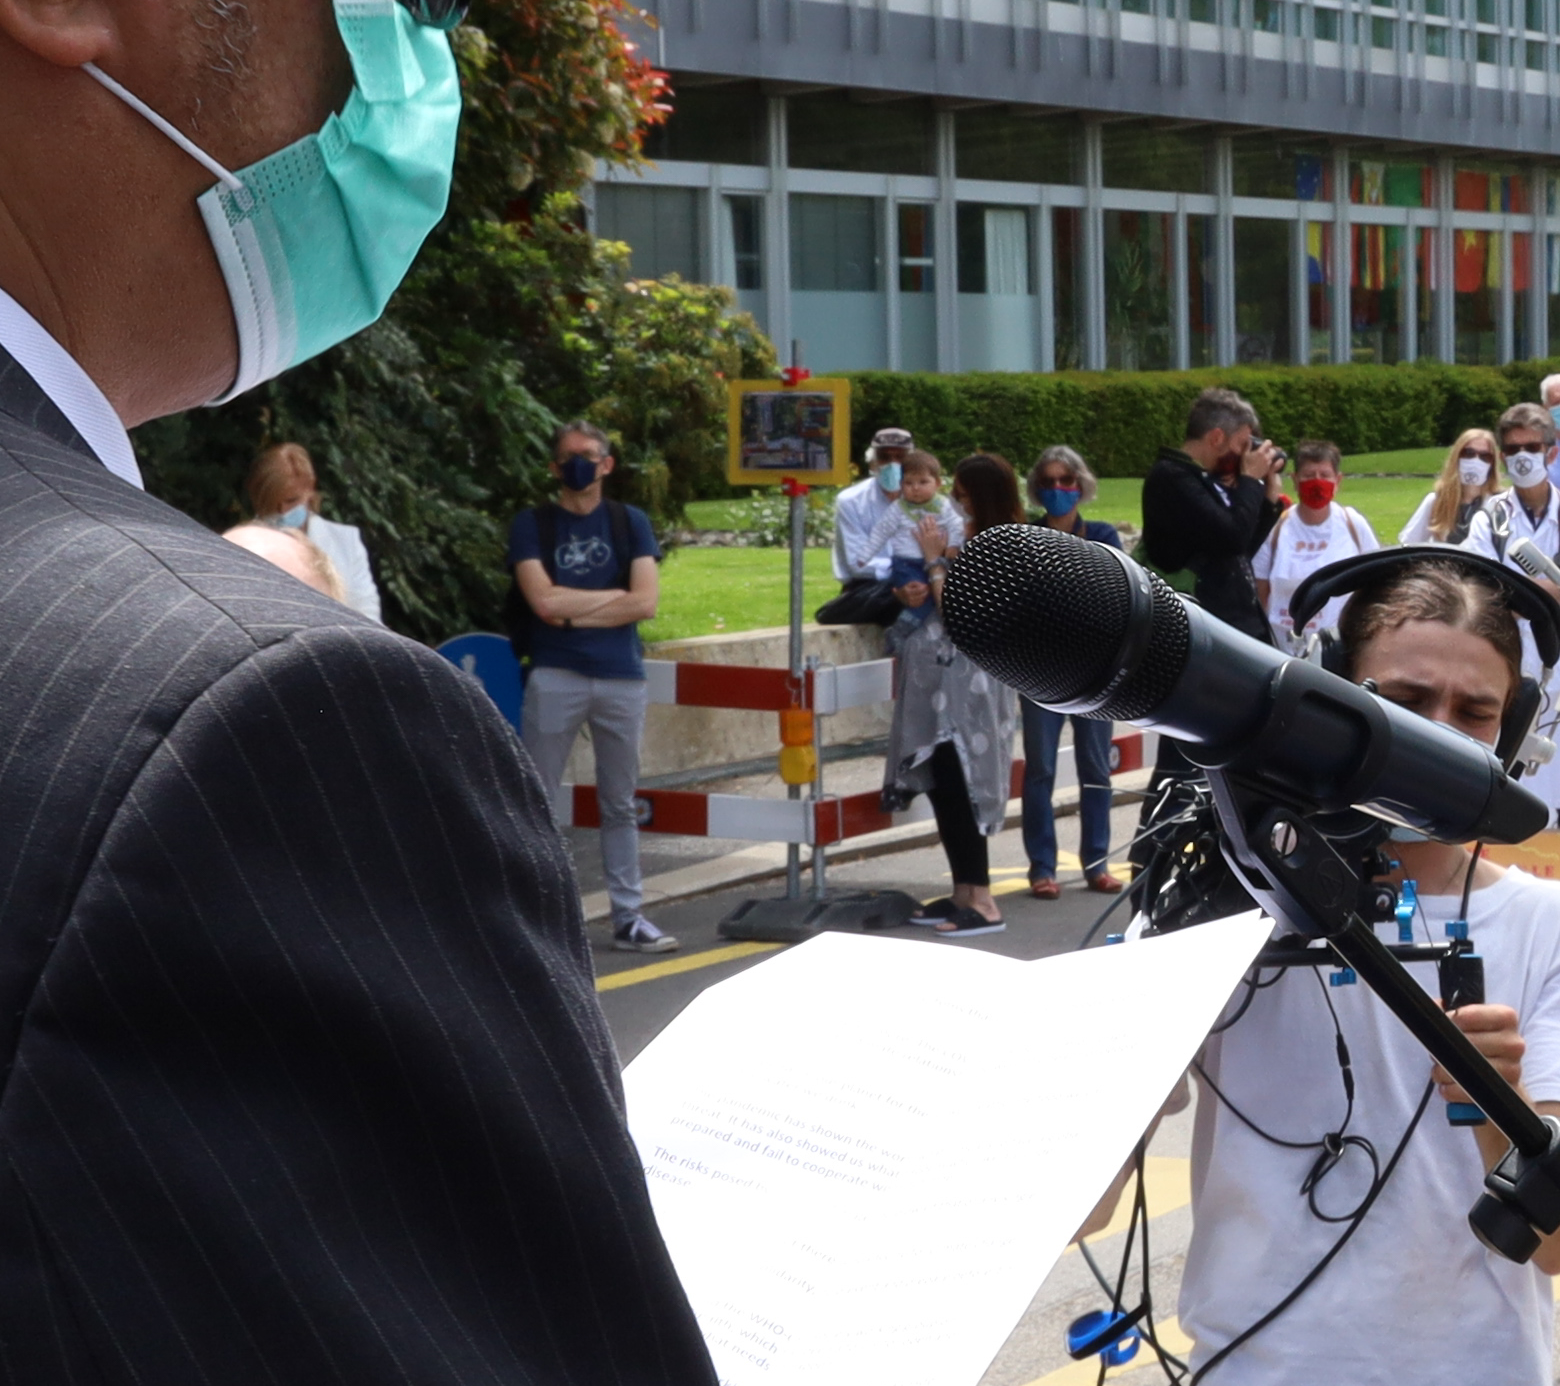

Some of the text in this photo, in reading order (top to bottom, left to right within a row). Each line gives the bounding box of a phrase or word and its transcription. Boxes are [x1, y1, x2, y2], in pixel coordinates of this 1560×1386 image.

[669, 1116, 734, 1143] prepared
[733, 1137, 761, 1153] and
[761, 1144, 785, 1162] fail
[785, 1154, 800, 1166] to
[801, 1161, 869, 1187] cooperate
[741, 1118, 764, 1134] has
[766, 1129, 793, 1144] also
[795, 1138, 848, 1162] showed
[849, 1157, 864, 1168] us
[809, 1124, 853, 1145] shown
[653, 1145, 678, 1164] The
[679, 1157, 710, 1175] risks
[710, 1170, 754, 1187] posed
[731, 1344, 771, 1371] needs
